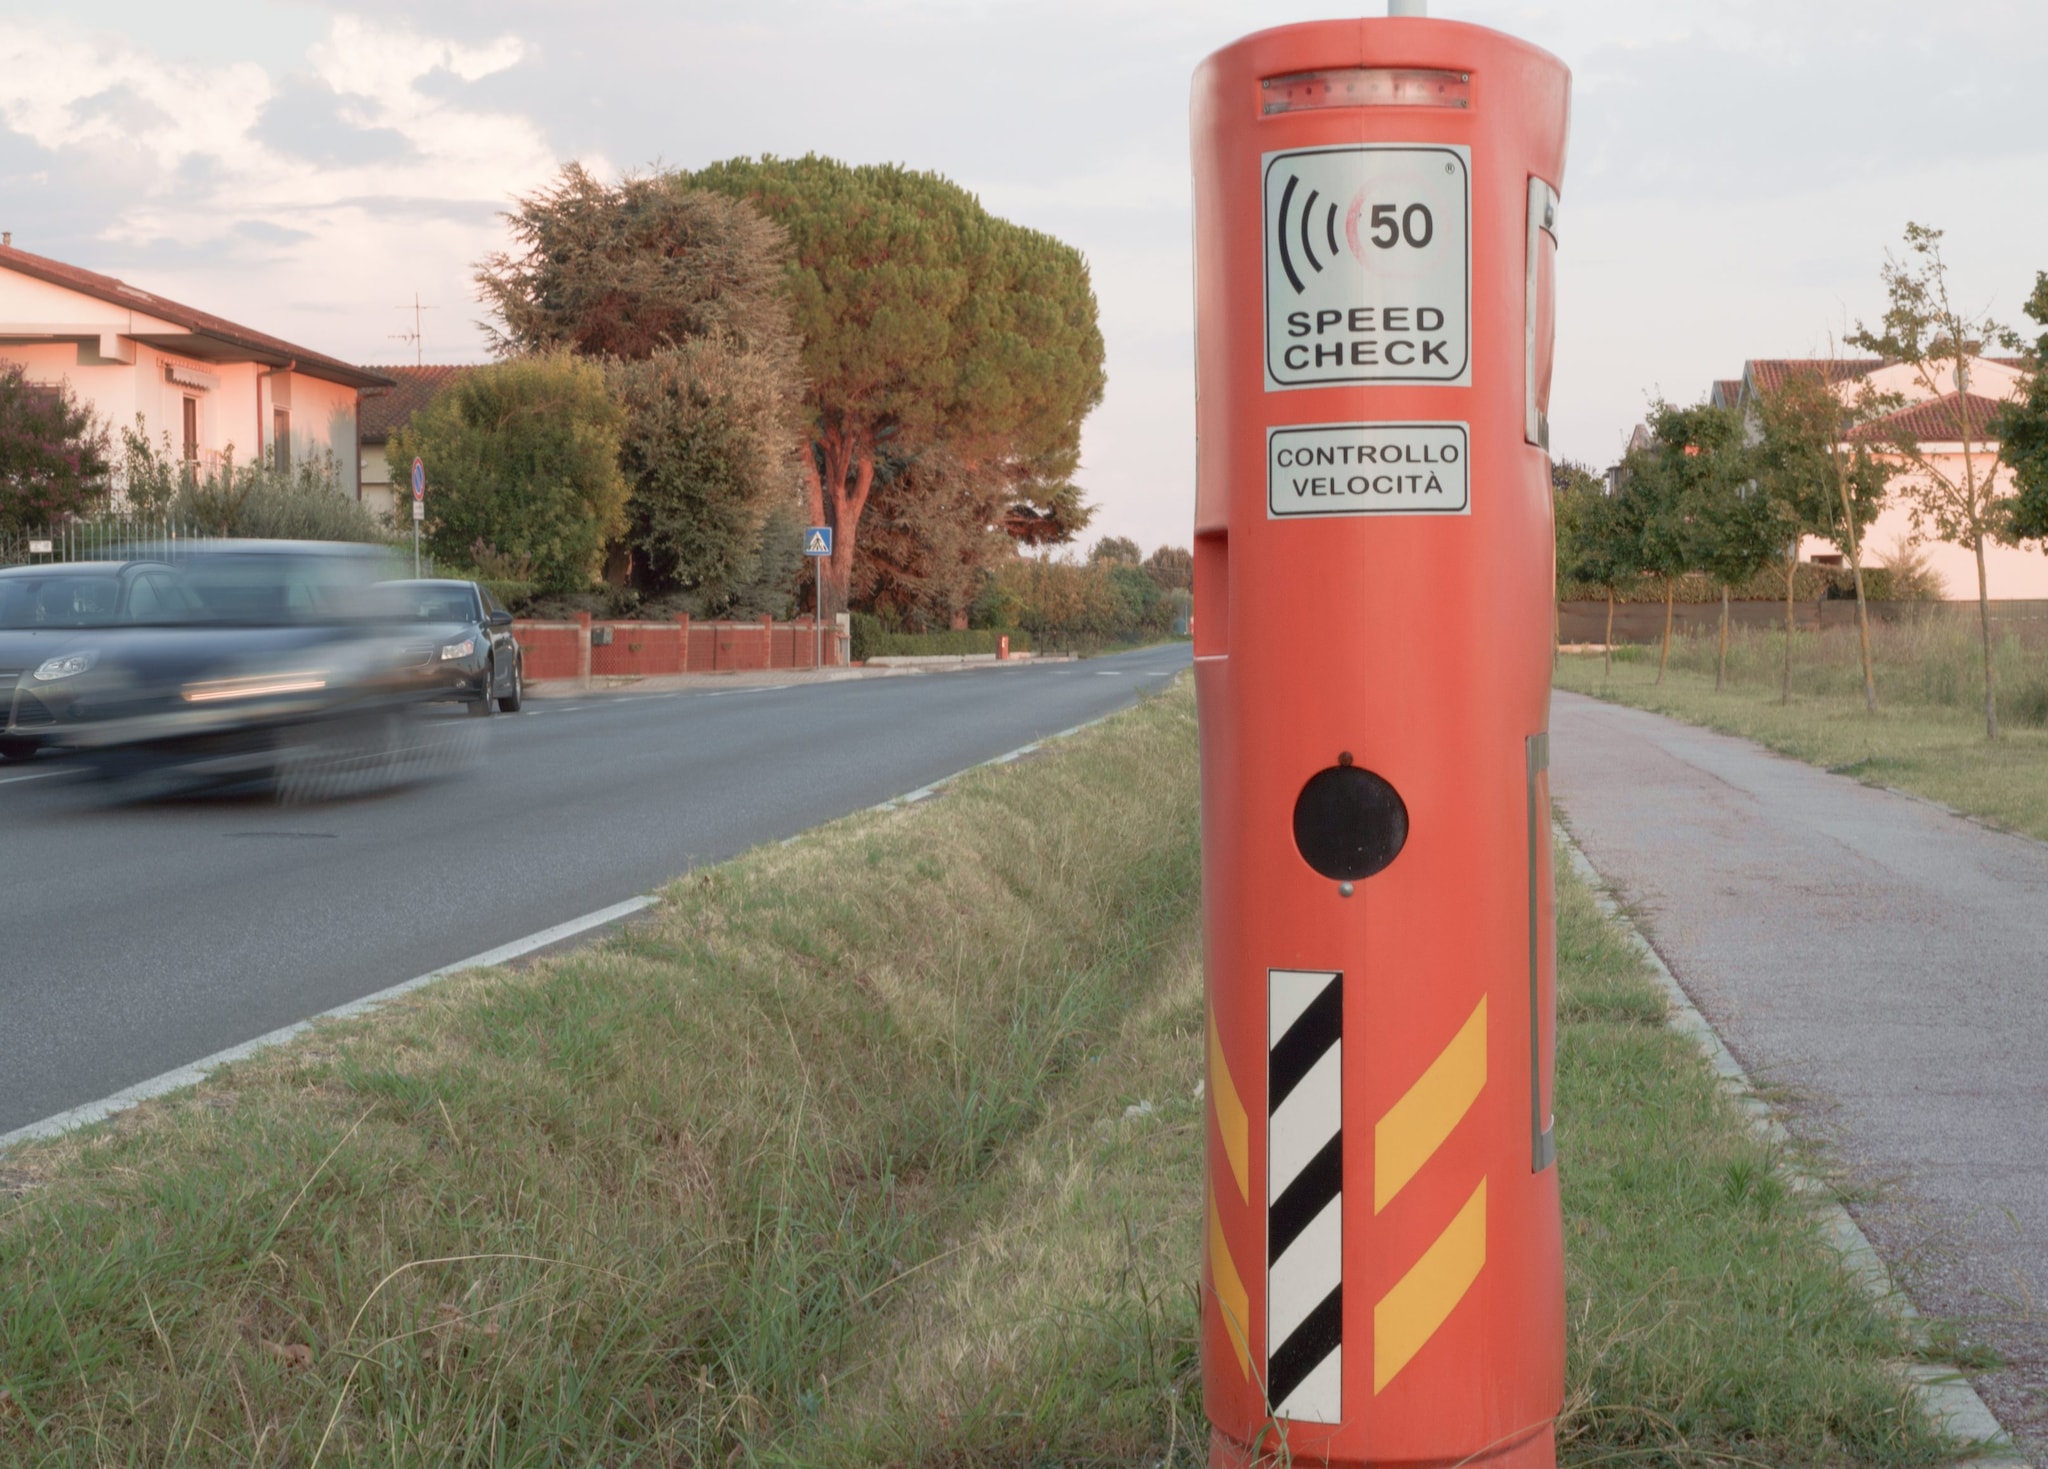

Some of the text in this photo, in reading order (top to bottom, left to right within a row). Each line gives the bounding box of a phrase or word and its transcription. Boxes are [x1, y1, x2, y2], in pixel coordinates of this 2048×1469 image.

[1371, 203, 1433, 249] 50
[1287, 307, 1445, 337] SPEED
[1284, 340, 1449, 370] CHECK
[1277, 444, 1459, 468] CONTROLLO
[1292, 470, 1443, 497] VELOCITÀ
